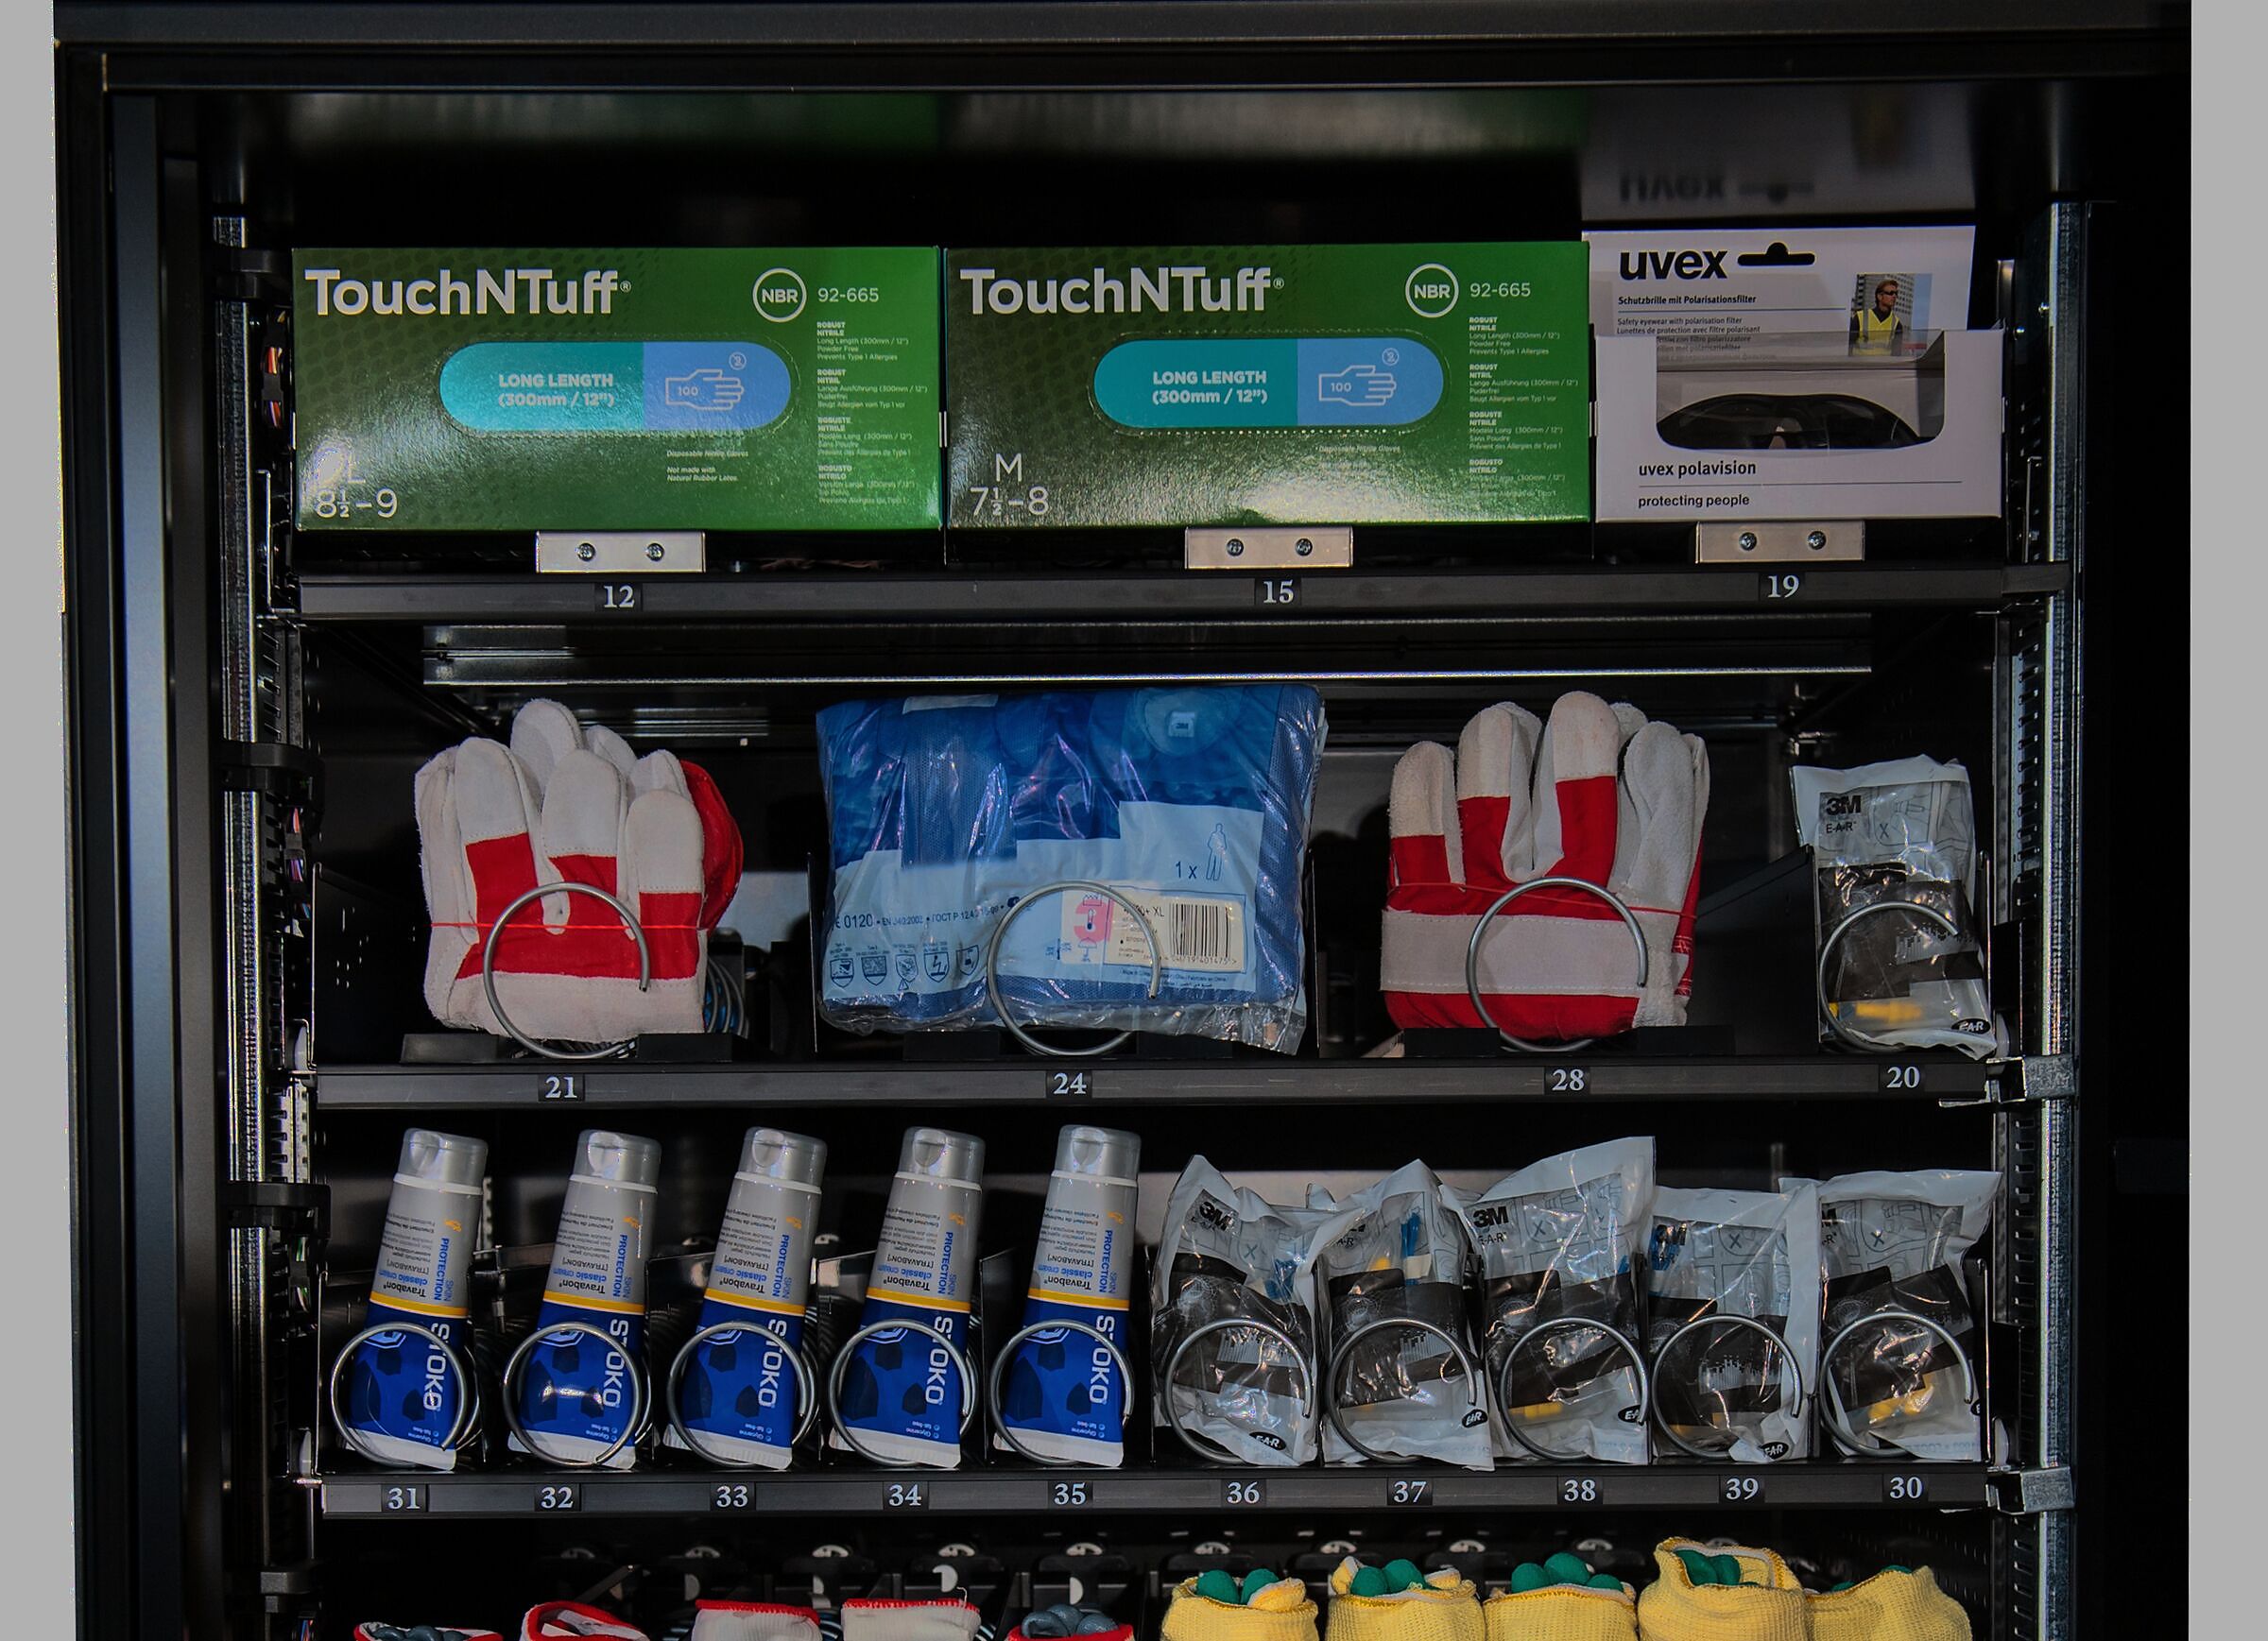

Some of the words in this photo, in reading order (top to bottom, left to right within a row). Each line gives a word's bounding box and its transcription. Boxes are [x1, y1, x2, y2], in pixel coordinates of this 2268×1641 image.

[1619, 249, 1728, 281] uvex
[761, 289, 798, 303] NBR
[817, 287, 879, 302] 92-665
[1415, 284, 1450, 299] NBR
[1469, 282, 1531, 298] 92-665
[1618, 296, 1667, 305] Schutzbrille
[1668, 295, 1682, 304] mit
[1684, 294, 1757, 304] Polarisationsfilter
[1685, 317, 1725, 326] polarisation
[499, 373, 544, 388] LONG
[548, 373, 613, 388] LENGTH
[1153, 370, 1198, 385] LONG
[1202, 369, 1266, 385] LENGTH
[1331, 382, 1351, 392] 100
[498, 392, 567, 408] (300mm
[570, 392, 579, 407] /
[678, 385, 698, 397] 100
[1152, 390, 1221, 405] (300mm
[1223, 390, 1233, 404] /
[995, 453, 1022, 482] M
[1639, 464, 1675, 476] uvex
[1678, 459, 1757, 479] polavision
[1638, 494, 1703, 509] protecting
[1706, 494, 1750, 507] people
[604, 585, 635, 607] 12
[1263, 579, 1294, 604] 15
[1768, 575, 1799, 598] 19
[1826, 795, 1862, 816] 3M
[1176, 861, 1181, 879] 1
[844, 914, 873, 929] 0120
[1152, 906, 1165, 917] XL
[545, 1076, 577, 1098] 21
[1054, 1072, 1087, 1094] 24
[1552, 1069, 1585, 1091] 28
[1886, 1066, 1919, 1088] 20
[1472, 1206, 1509, 1228] 3M
[434, 1238, 450, 1301] PROTECTION
[612, 1234, 627, 1297] PROTECTION
[772, 1234, 790, 1297] PROTECTION
[937, 1231, 954, 1294] PROTECTION
[1099, 1230, 1113, 1293] PROTECTION
[387, 1487, 420, 1510] 31
[541, 1487, 574, 1509] 32
[716, 1485, 748, 1508] 33
[888, 1484, 922, 1507] 34
[1054, 1482, 1086, 1505] 35
[1228, 1481, 1260, 1504] 36
[1393, 1480, 1427, 1503] 37
[1564, 1479, 1596, 1501] 38
[1726, 1478, 1759, 1500] 39
[1890, 1477, 1923, 1499] 30
